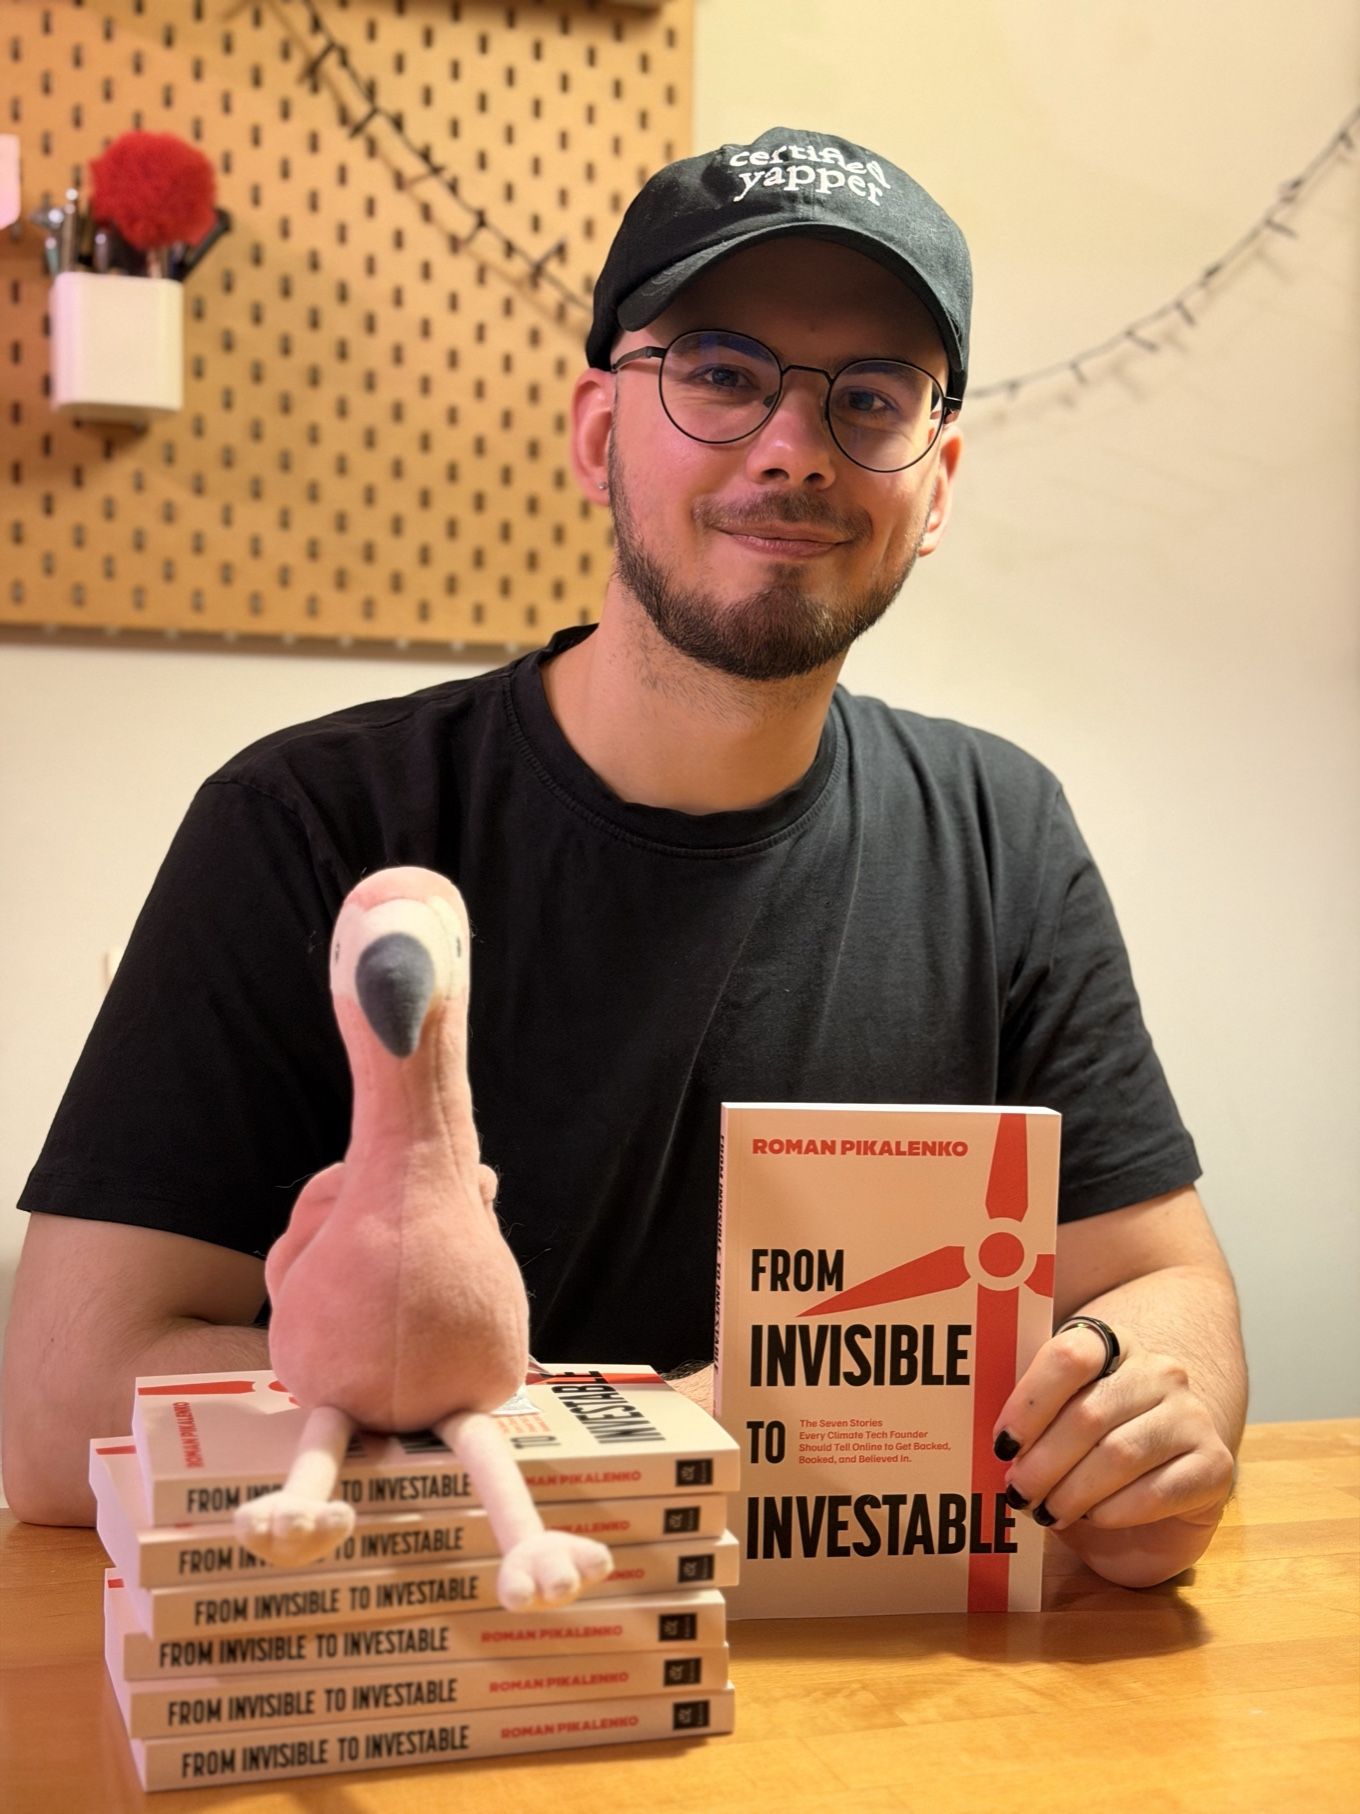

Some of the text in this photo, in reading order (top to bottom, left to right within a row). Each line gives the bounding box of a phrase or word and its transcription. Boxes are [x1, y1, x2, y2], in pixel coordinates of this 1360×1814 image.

[729, 144, 891, 190] certified
[733, 164, 884, 207] yapper
[752, 1138, 969, 1157] ROMAN PIKALENKO
[751, 1249, 844, 1292] FROM
[750, 1324, 972, 1387] INVISIBLE
[545, 1370, 666, 1444] INVESTABLE
[799, 1418, 883, 1428] The Seven Stories
[746, 1420, 785, 1464] TO
[799, 1430, 928, 1441] Every Climate Tech Founder
[799, 1442, 952, 1452] Should Tell Online to Get Backed,
[798, 1454, 913, 1465] Booked, and Believed In.
[187, 1485, 240, 1512] FROM
[341, 1479, 363, 1503] TO
[368, 1472, 472, 1502] INVESTABLE
[560, 1470, 642, 1486] PIKALENKO
[746, 1492, 1018, 1560] INVESTABLE
[178, 1546, 232, 1574] FROM
[361, 1526, 464, 1558] INVESTABLE
[195, 1576, 479, 1626] FROM INVISIBLE TO INVESTABLE
[160, 1624, 624, 1668] FROM INVISIBLE TO INVESTABLE ROMAN PIKALENKO
[168, 1671, 630, 1727] FROM INVISIBLE TO INVESTABLE ROMAN PIKALENKO
[181, 1715, 641, 1778] FROM INVISIBLE TO INVESTABLE ROMAN PIKALENKO
